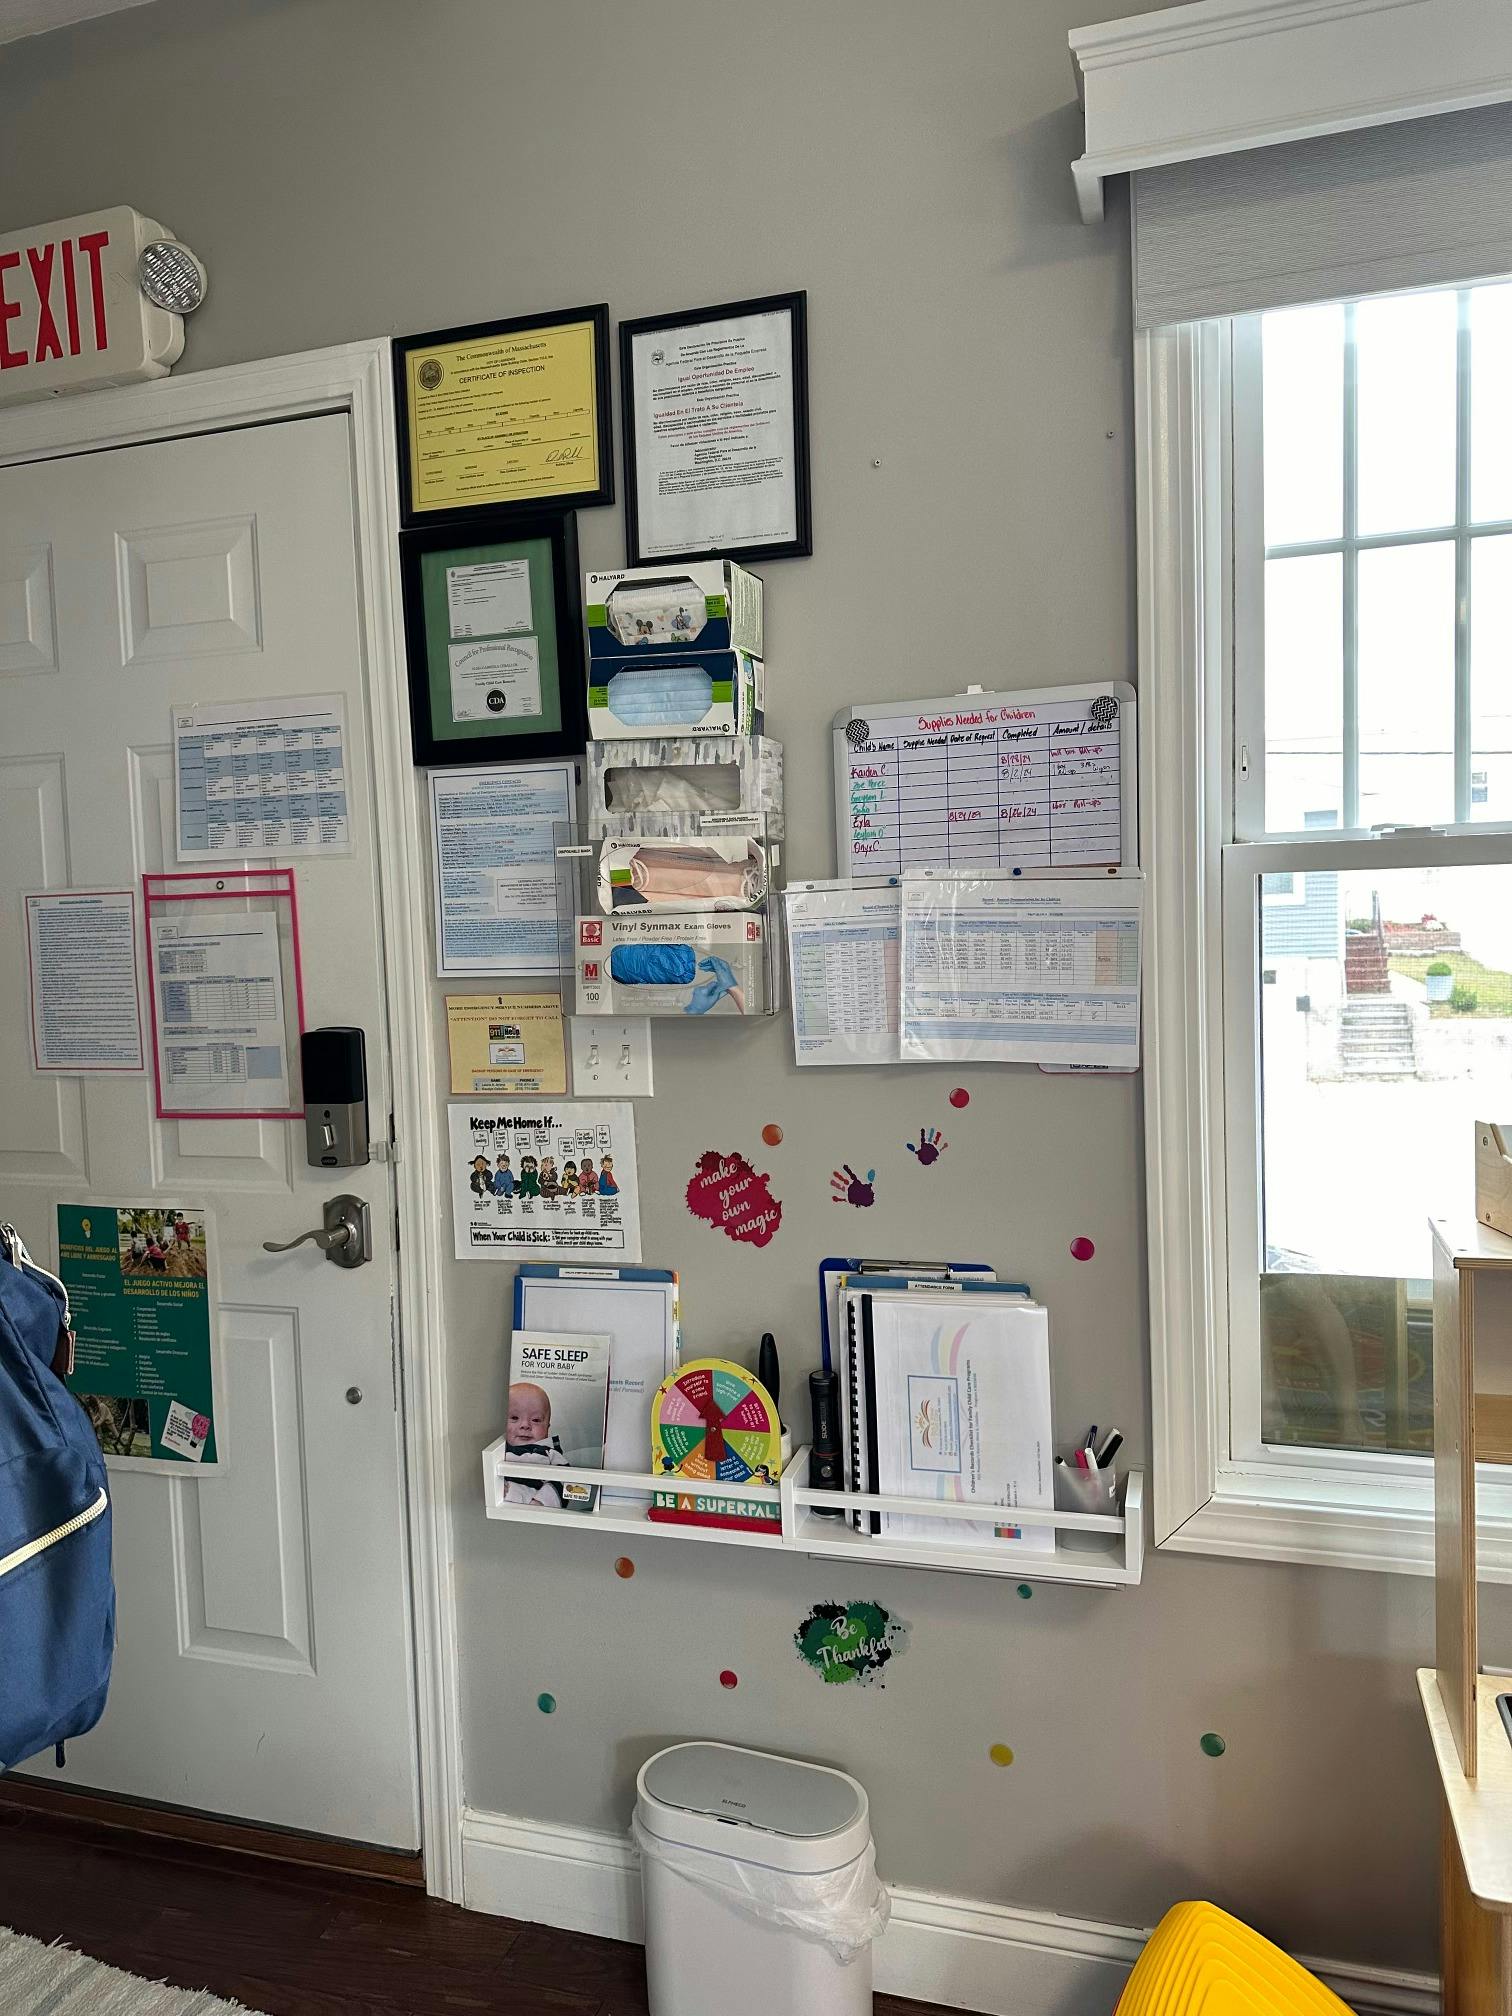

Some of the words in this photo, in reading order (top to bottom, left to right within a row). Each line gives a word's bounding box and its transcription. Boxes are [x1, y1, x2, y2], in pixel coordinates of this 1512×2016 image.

[0, 231, 109, 370] EXIT
[466, 349, 504, 360] Commonwealth
[505, 346, 511, 354] of
[512, 342, 546, 352] Massachusetts
[459, 372, 497, 384] CERTIFICATE
[498, 370, 507, 378] OF
[508, 365, 545, 376] INSPECTION
[692, 370, 725, 380] Oportunidad
[734, 366, 755, 374] Empleo
[654, 410, 676, 419] Igualdad
[598, 574, 625, 582] HALYARD
[454, 651, 472, 668] Council
[918, 716, 954, 732] Supplies
[956, 712, 984, 726] Needed
[986, 710, 998, 724] for
[1000, 707, 1036, 720] Children
[854, 741, 876, 753] Child's
[879, 741, 894, 751] Name
[926, 736, 948, 745] Needed
[966, 733, 973, 741] of
[1002, 727, 1038, 742] Completed
[1052, 723, 1080, 736] Amount
[1088, 720, 1112, 732] details
[612, 922, 637, 932] Vinyl
[640, 922, 680, 932] Synmax
[582, 936, 600, 944] Basic
[584, 964, 598, 977] M
[586, 992, 600, 1000] 100
[470, 1117, 496, 1134] Keep
[496, 1117, 513, 1128] Me
[513, 1117, 542, 1129] Home
[543, 1116, 562, 1128] If...
[700, 1159, 738, 1188] make
[719, 1177, 753, 1208] your
[722, 1200, 751, 1221] own
[735, 1210, 778, 1236] magic
[473, 1232, 491, 1242] When
[492, 1232, 507, 1241] Your
[508, 1231, 526, 1241] Child
[526, 1232, 531, 1241] is
[532, 1232, 551, 1242] Sick:
[152, 1280, 172, 1288] ACTIVO
[173, 1281, 198, 1289] MEJORA
[123, 1288, 159, 1296] DESARROLLO
[181, 1290, 199, 1298] NIÑOS
[522, 1348, 551, 1360] SAFE
[554, 1349, 588, 1362] SLEEP
[521, 1360, 534, 1368] FOR
[536, 1361, 555, 1369] YOUR
[682, 1374, 705, 1386] Introduce
[684, 1464, 696, 1475] being
[720, 1467, 739, 1477] someone
[656, 1493, 675, 1508] BE
[681, 1497, 691, 1510] A
[830, 1616, 858, 1640] Be
[816, 1637, 890, 1669] Thankfu
